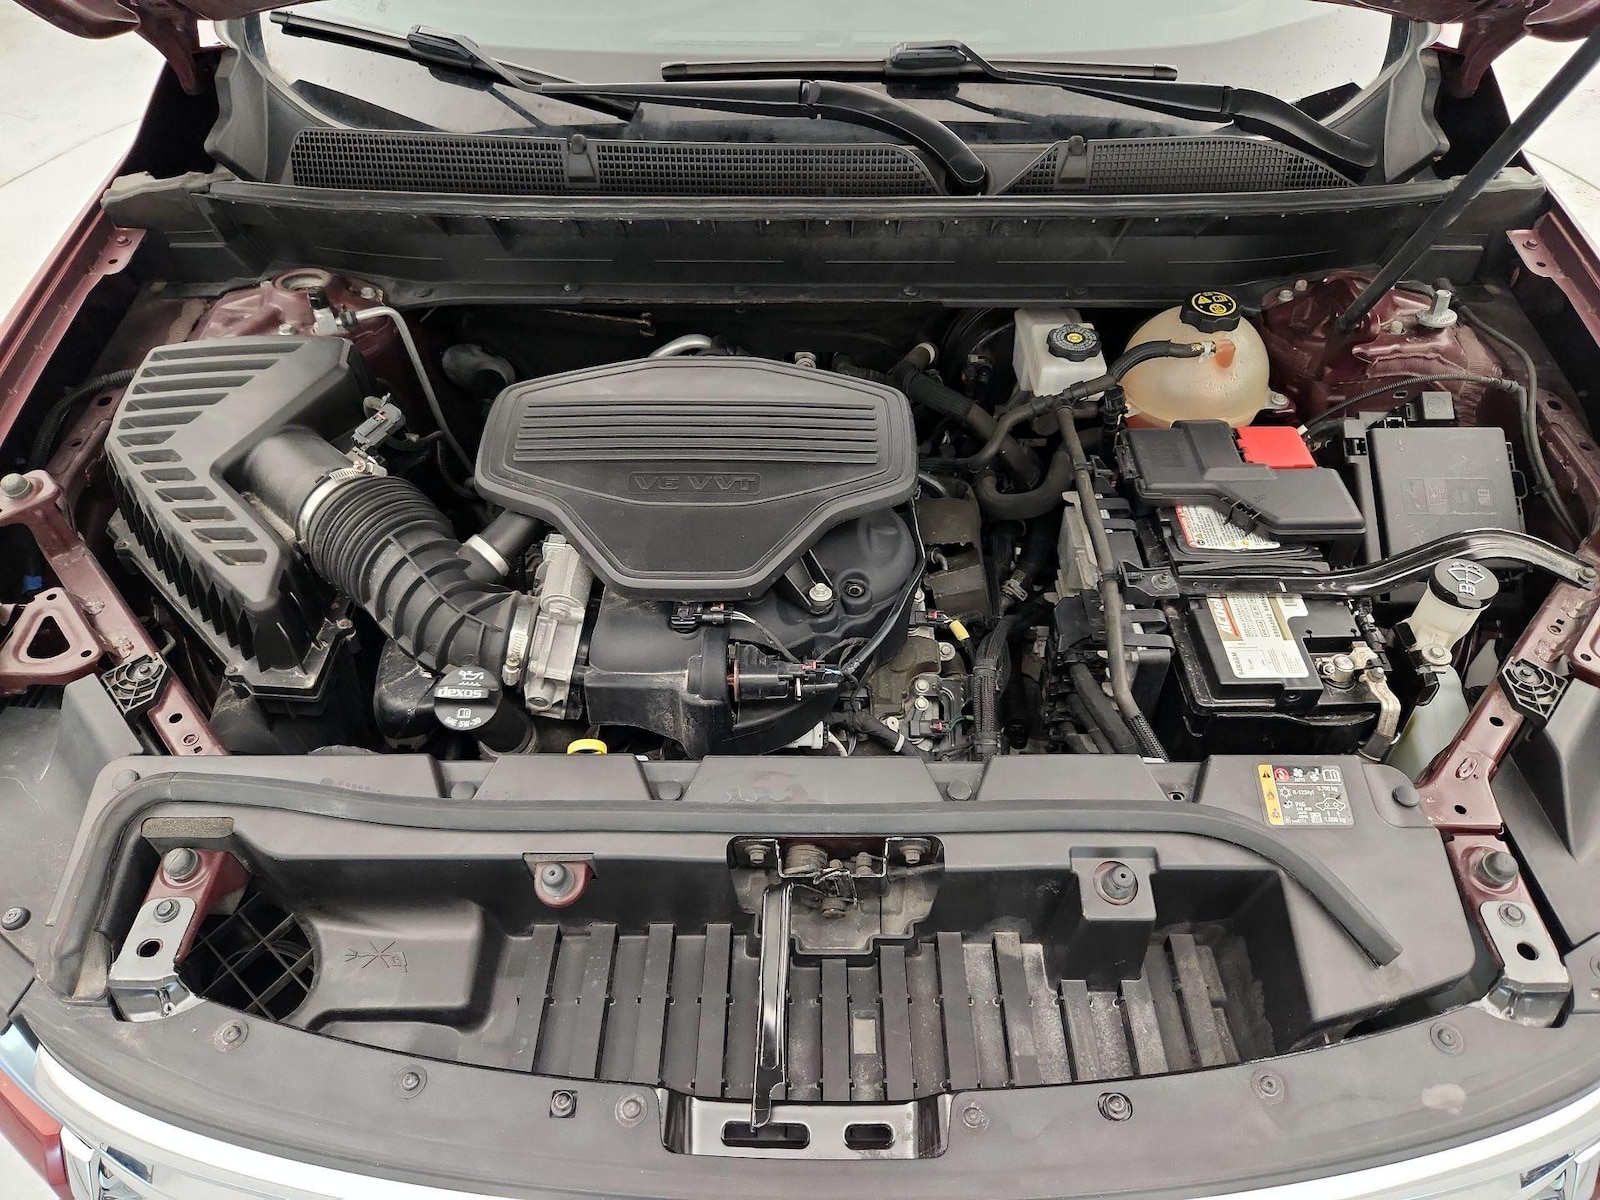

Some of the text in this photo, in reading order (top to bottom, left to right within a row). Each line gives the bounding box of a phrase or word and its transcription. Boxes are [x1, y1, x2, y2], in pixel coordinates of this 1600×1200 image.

[634, 475, 756, 491] V6 VVT
[437, 686, 483, 698] dexos
[445, 716, 482, 727] SAE 5W-30
